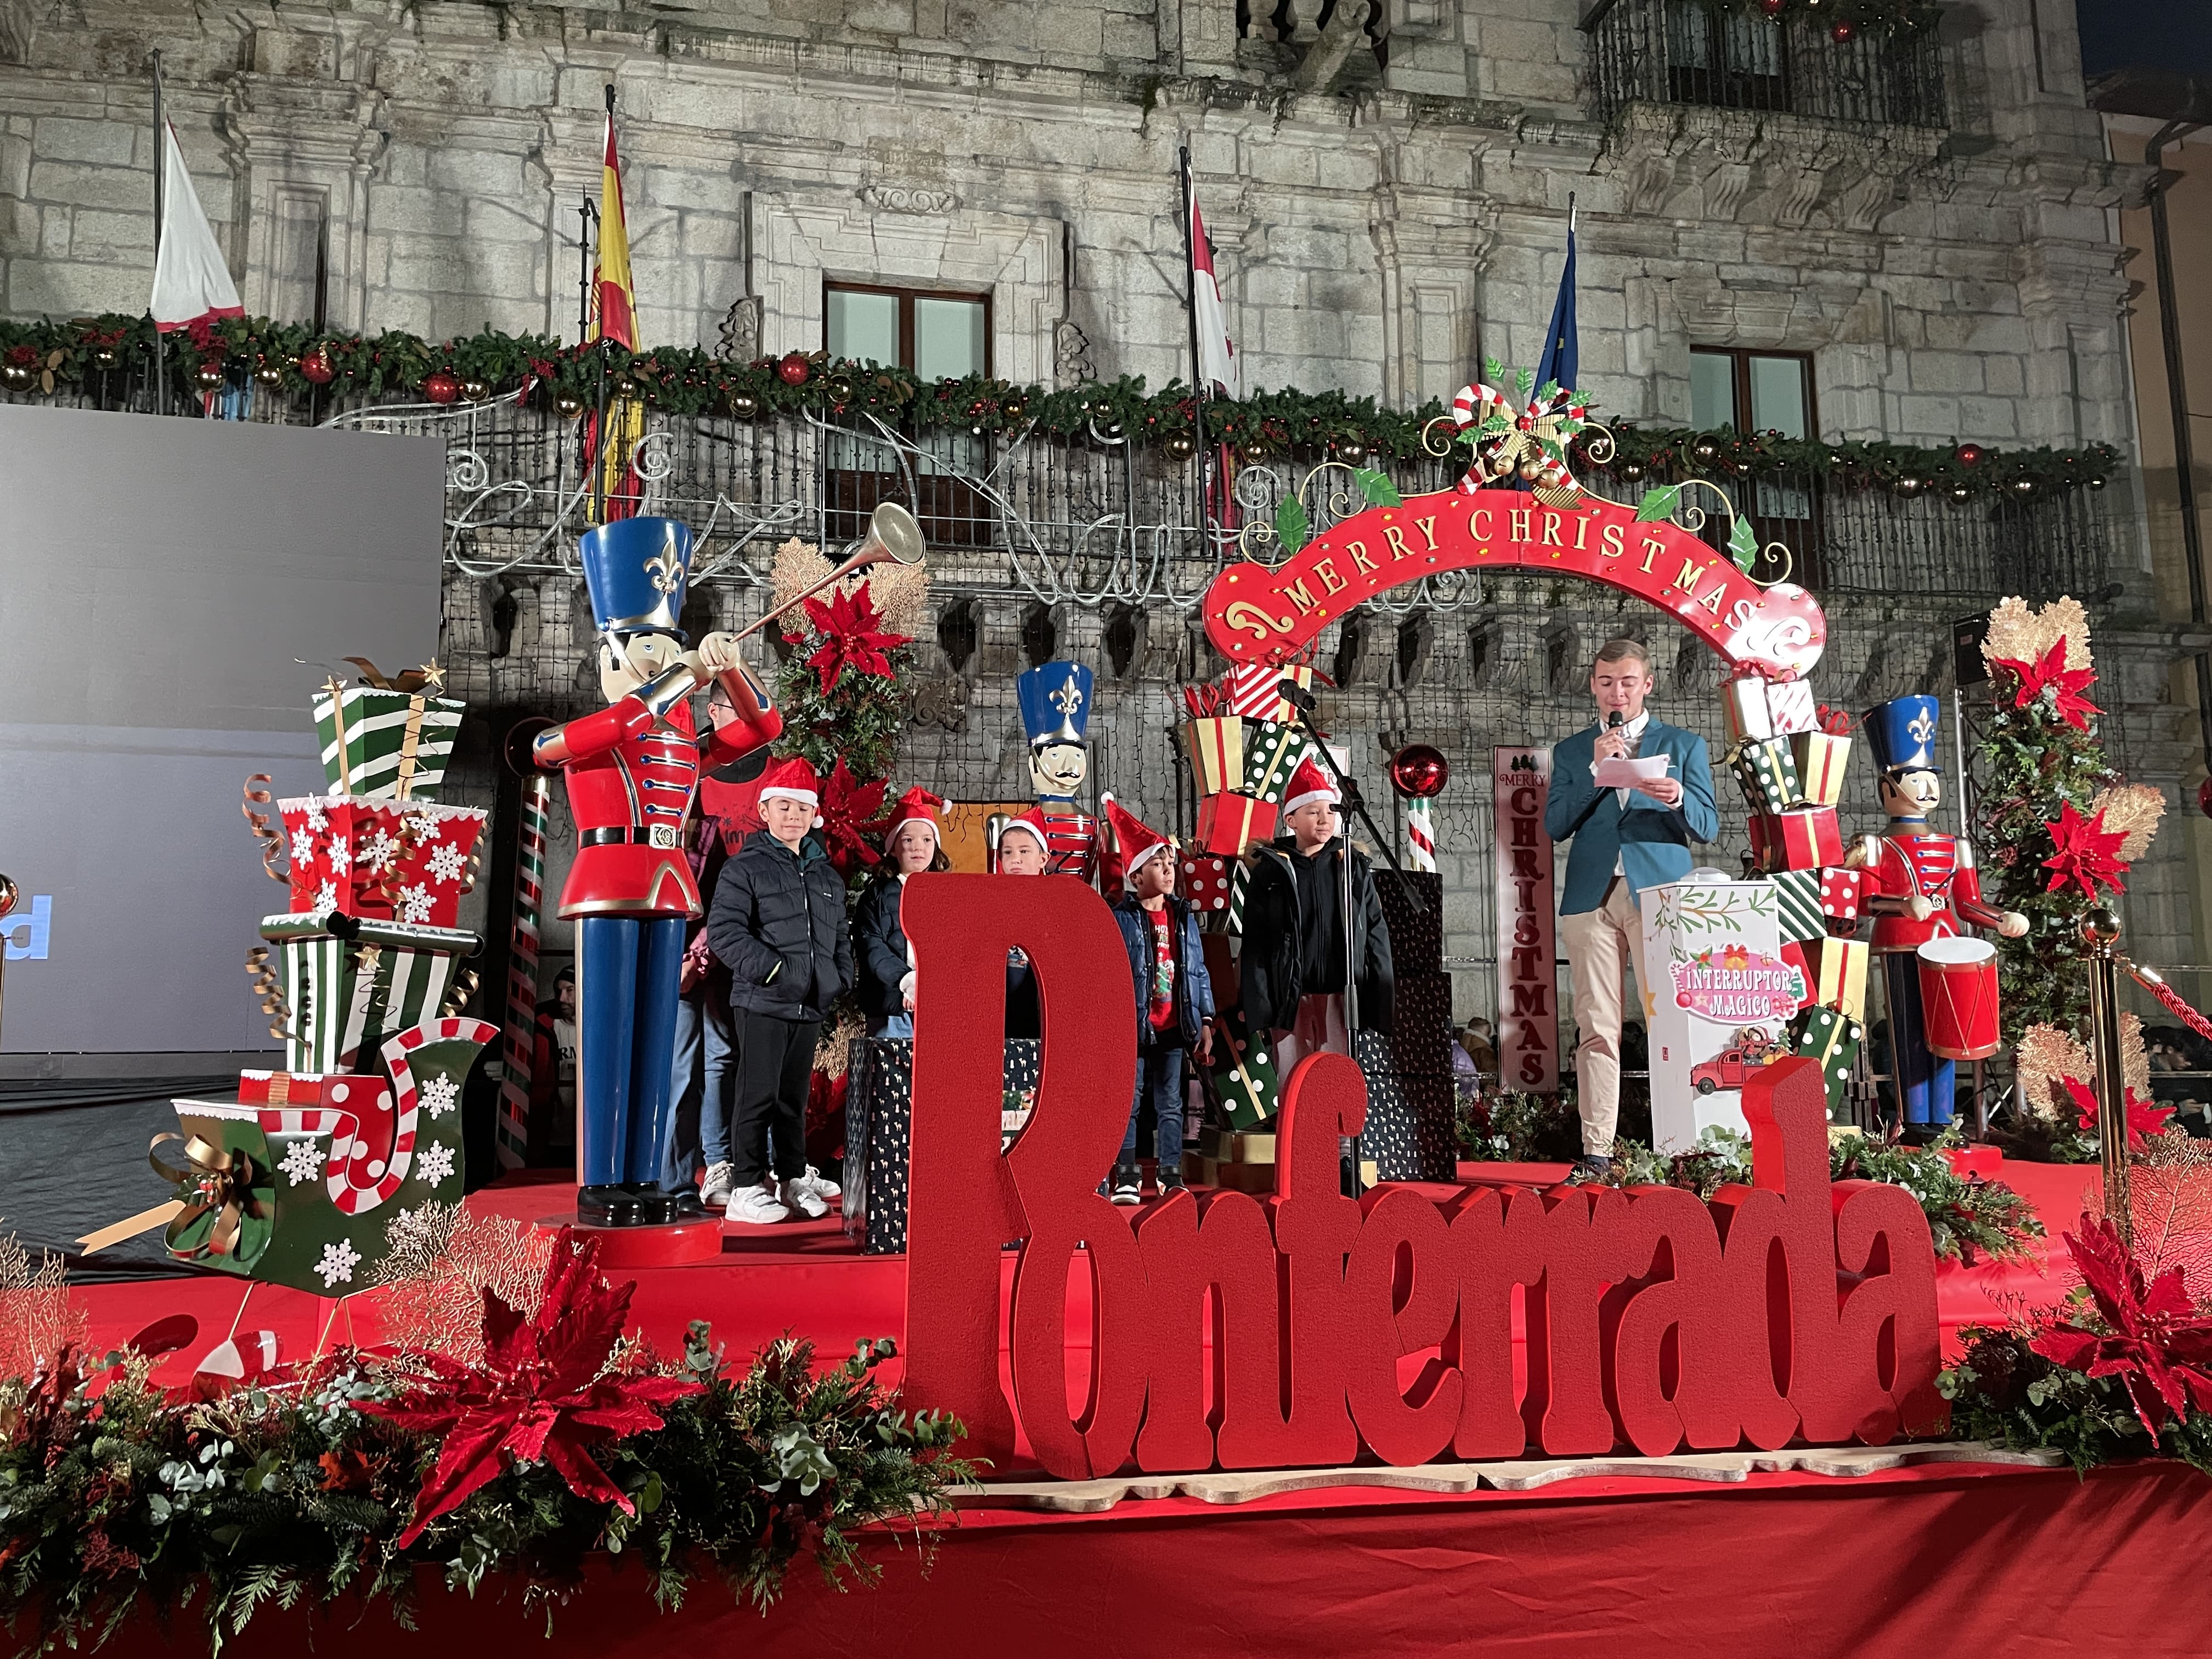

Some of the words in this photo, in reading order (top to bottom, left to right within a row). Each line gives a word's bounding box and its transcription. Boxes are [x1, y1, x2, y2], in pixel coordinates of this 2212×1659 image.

[1283, 515, 1441, 617] MERRY
[1469, 508, 1757, 632] CHRISTMAS
[1499, 774, 1546, 786] MERRY
[1510, 787, 1548, 1086] CHRISTMAS
[901, 872, 1951, 1481] Ponferrada
